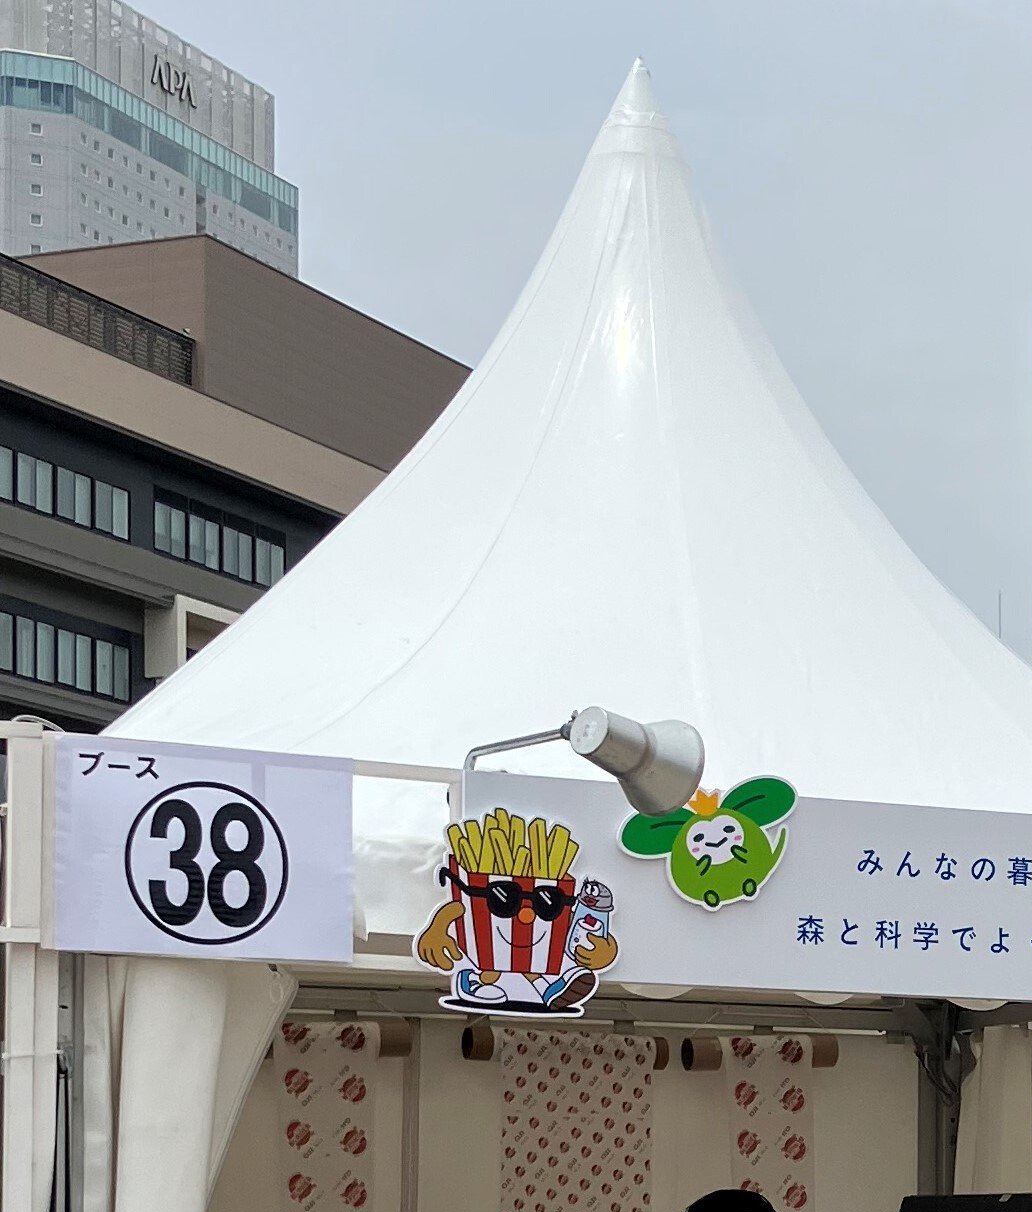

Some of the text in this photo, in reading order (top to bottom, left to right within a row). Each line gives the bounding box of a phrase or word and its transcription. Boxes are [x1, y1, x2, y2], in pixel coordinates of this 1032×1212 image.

[151, 53, 197, 109] APA
[78, 752, 159, 779] ブース
[149, 798, 267, 928] 38
